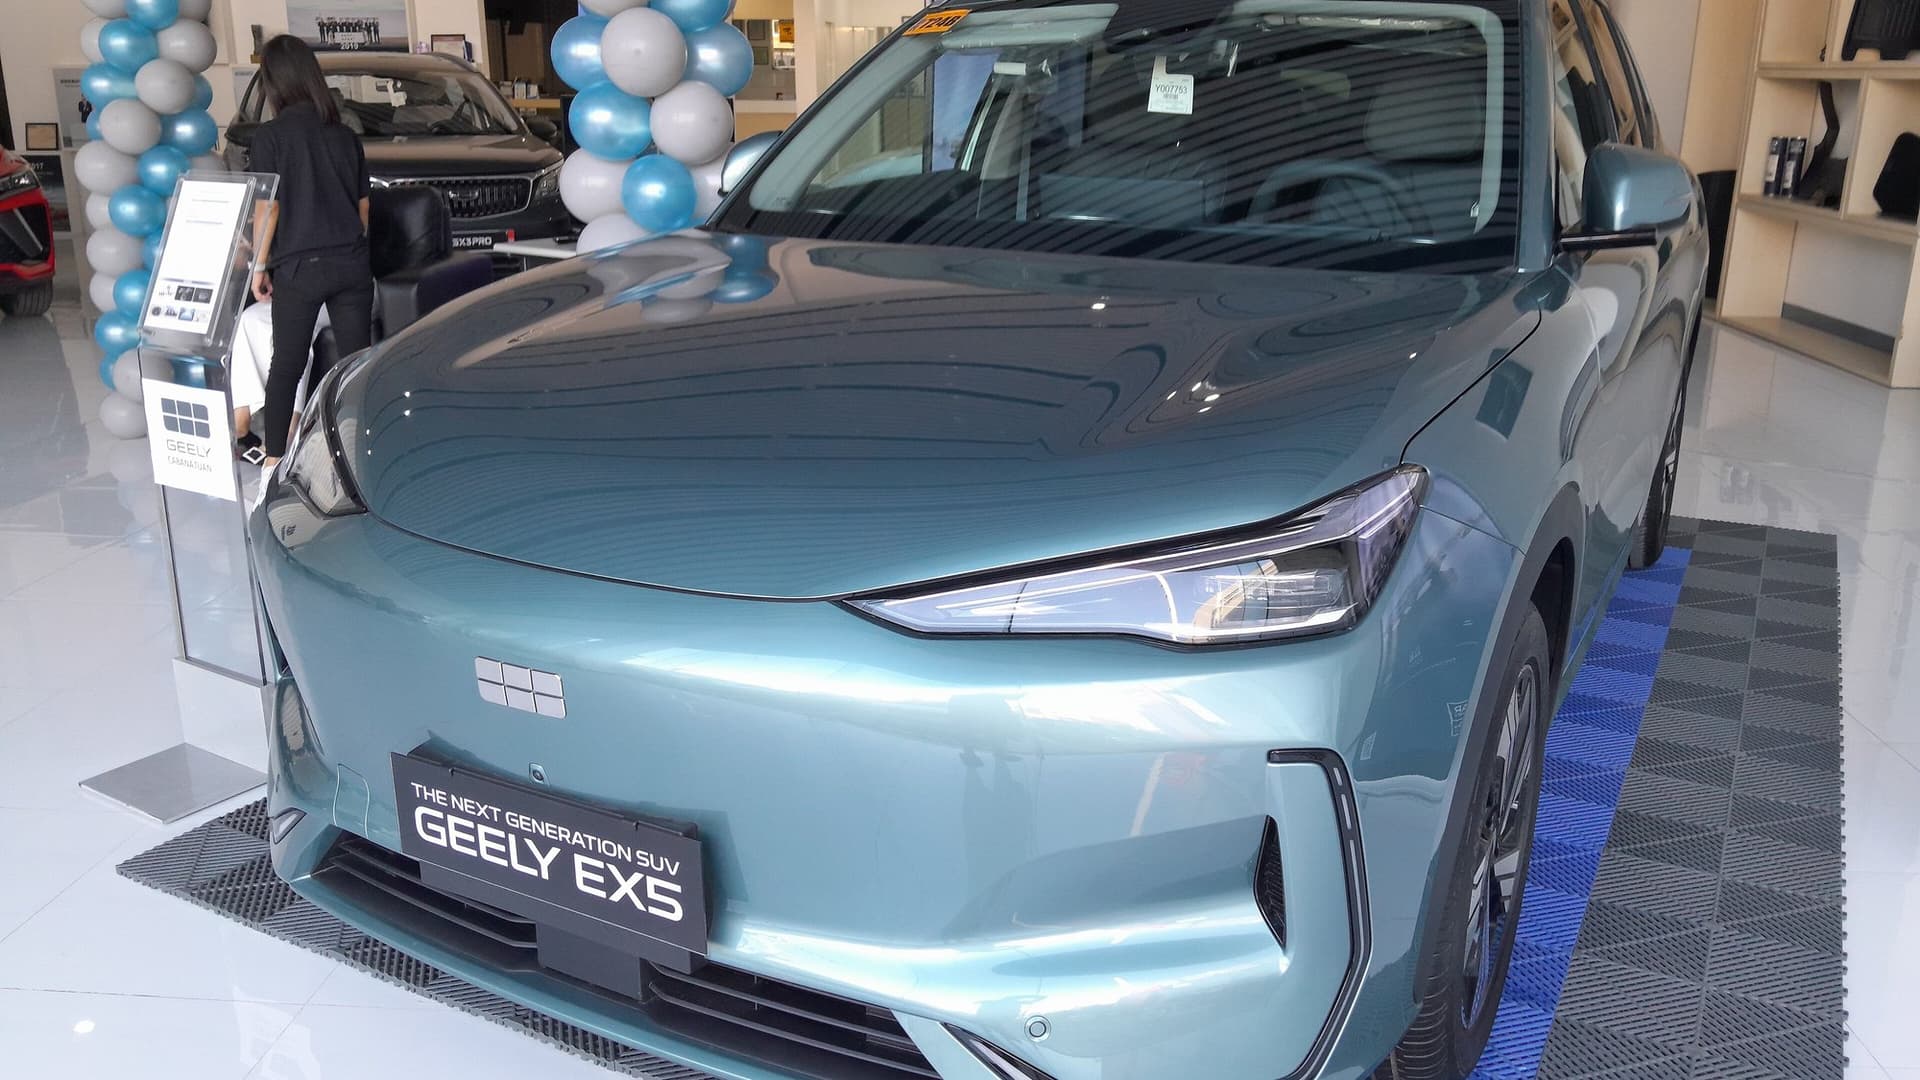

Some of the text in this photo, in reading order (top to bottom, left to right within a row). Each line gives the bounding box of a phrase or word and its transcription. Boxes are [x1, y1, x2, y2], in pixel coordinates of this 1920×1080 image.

[166, 439, 211, 458] GEELY
[167, 455, 212, 472] CABANATUAN
[410, 782, 681, 876] THE NEXT GENERATION SUV
[414, 805, 684, 922] GEELY EX5
